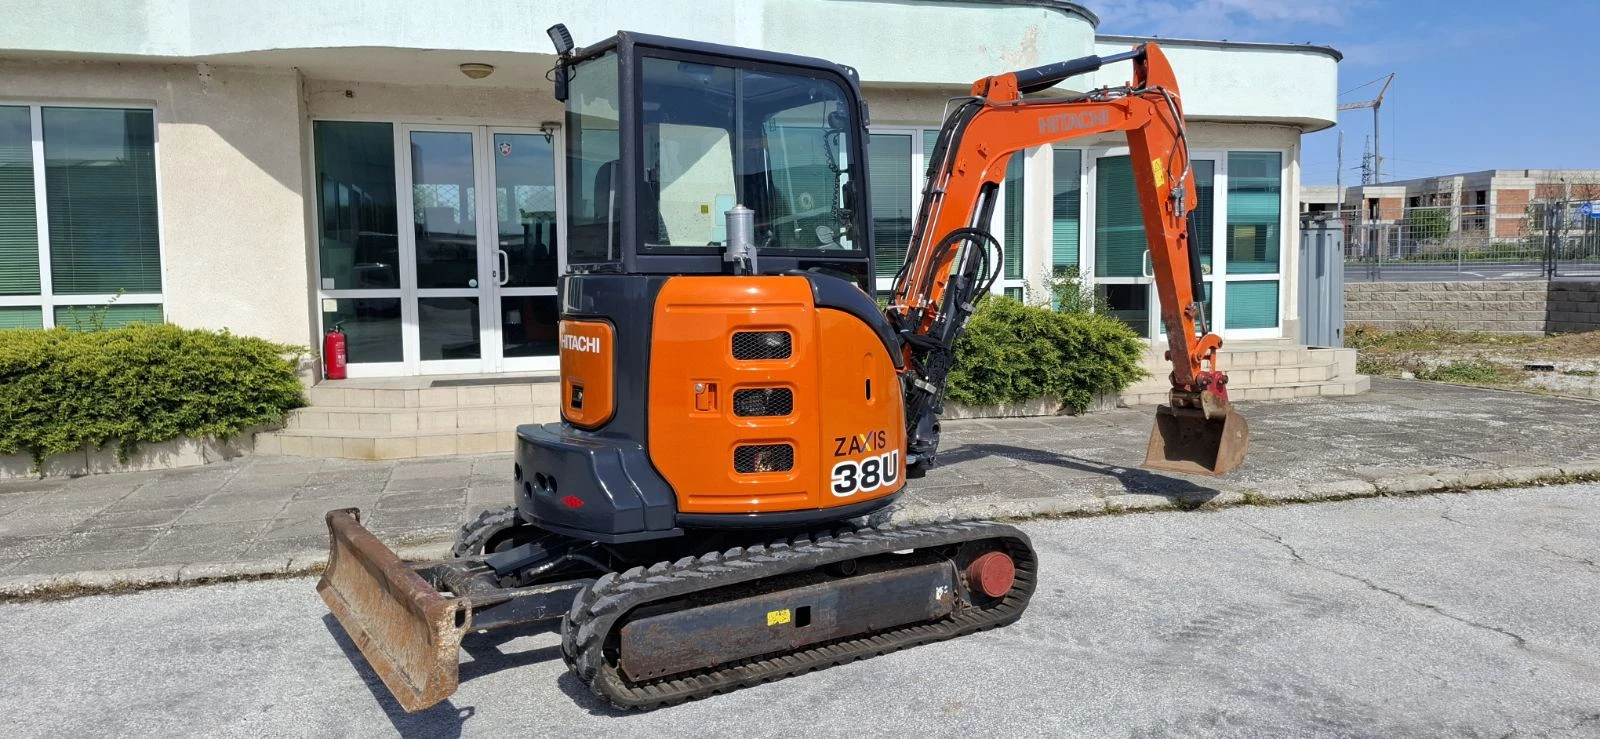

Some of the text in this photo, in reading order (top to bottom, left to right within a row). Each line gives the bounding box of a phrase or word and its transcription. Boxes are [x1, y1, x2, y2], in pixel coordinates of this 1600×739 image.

[1038, 109, 1109, 134] HITACHI
[561, 334, 600, 353] HITACHI
[834, 430, 886, 457] ZAXIS
[831, 449, 898, 497] 38U
